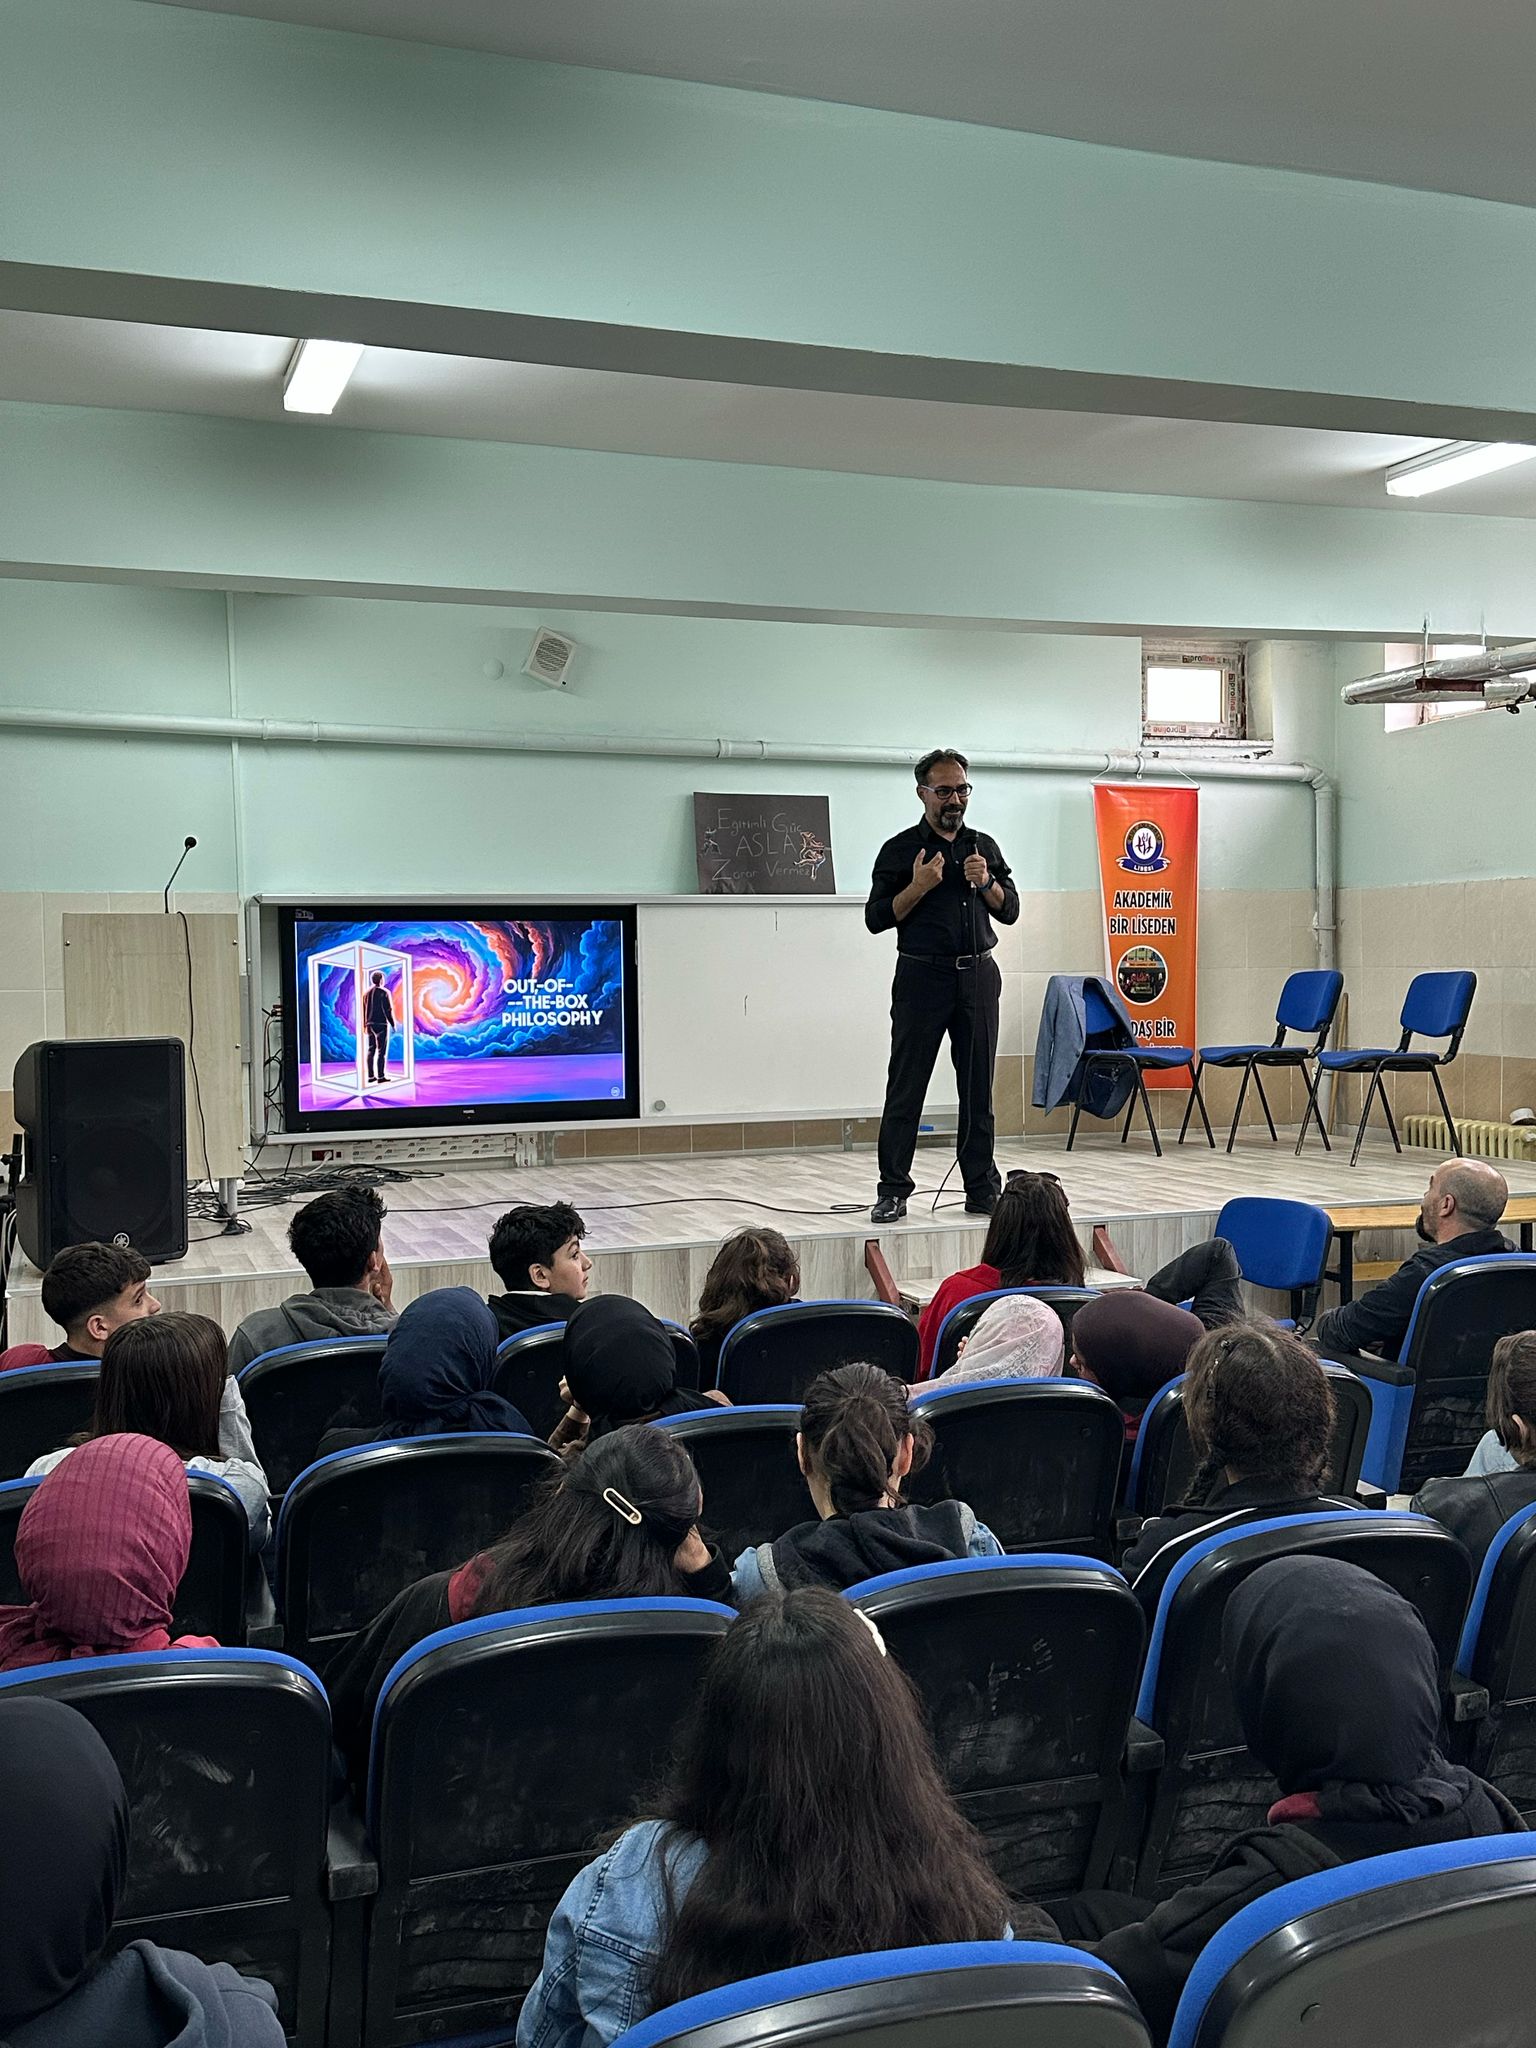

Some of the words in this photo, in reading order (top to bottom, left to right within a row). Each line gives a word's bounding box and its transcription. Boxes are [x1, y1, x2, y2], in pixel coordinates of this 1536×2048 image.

[736, 832, 797, 857] ASLA
[712, 859, 758, 880] Zarar
[1114, 889, 1172, 908] AKADEMİK
[1109, 915, 1129, 935] BİR
[1132, 915, 1176, 935] LİSEDEN
[502, 1009, 604, 1027] PHILOSOPHY
[1131, 1020, 1153, 1039] DAŞ
[1155, 1017, 1176, 1037] BİR
